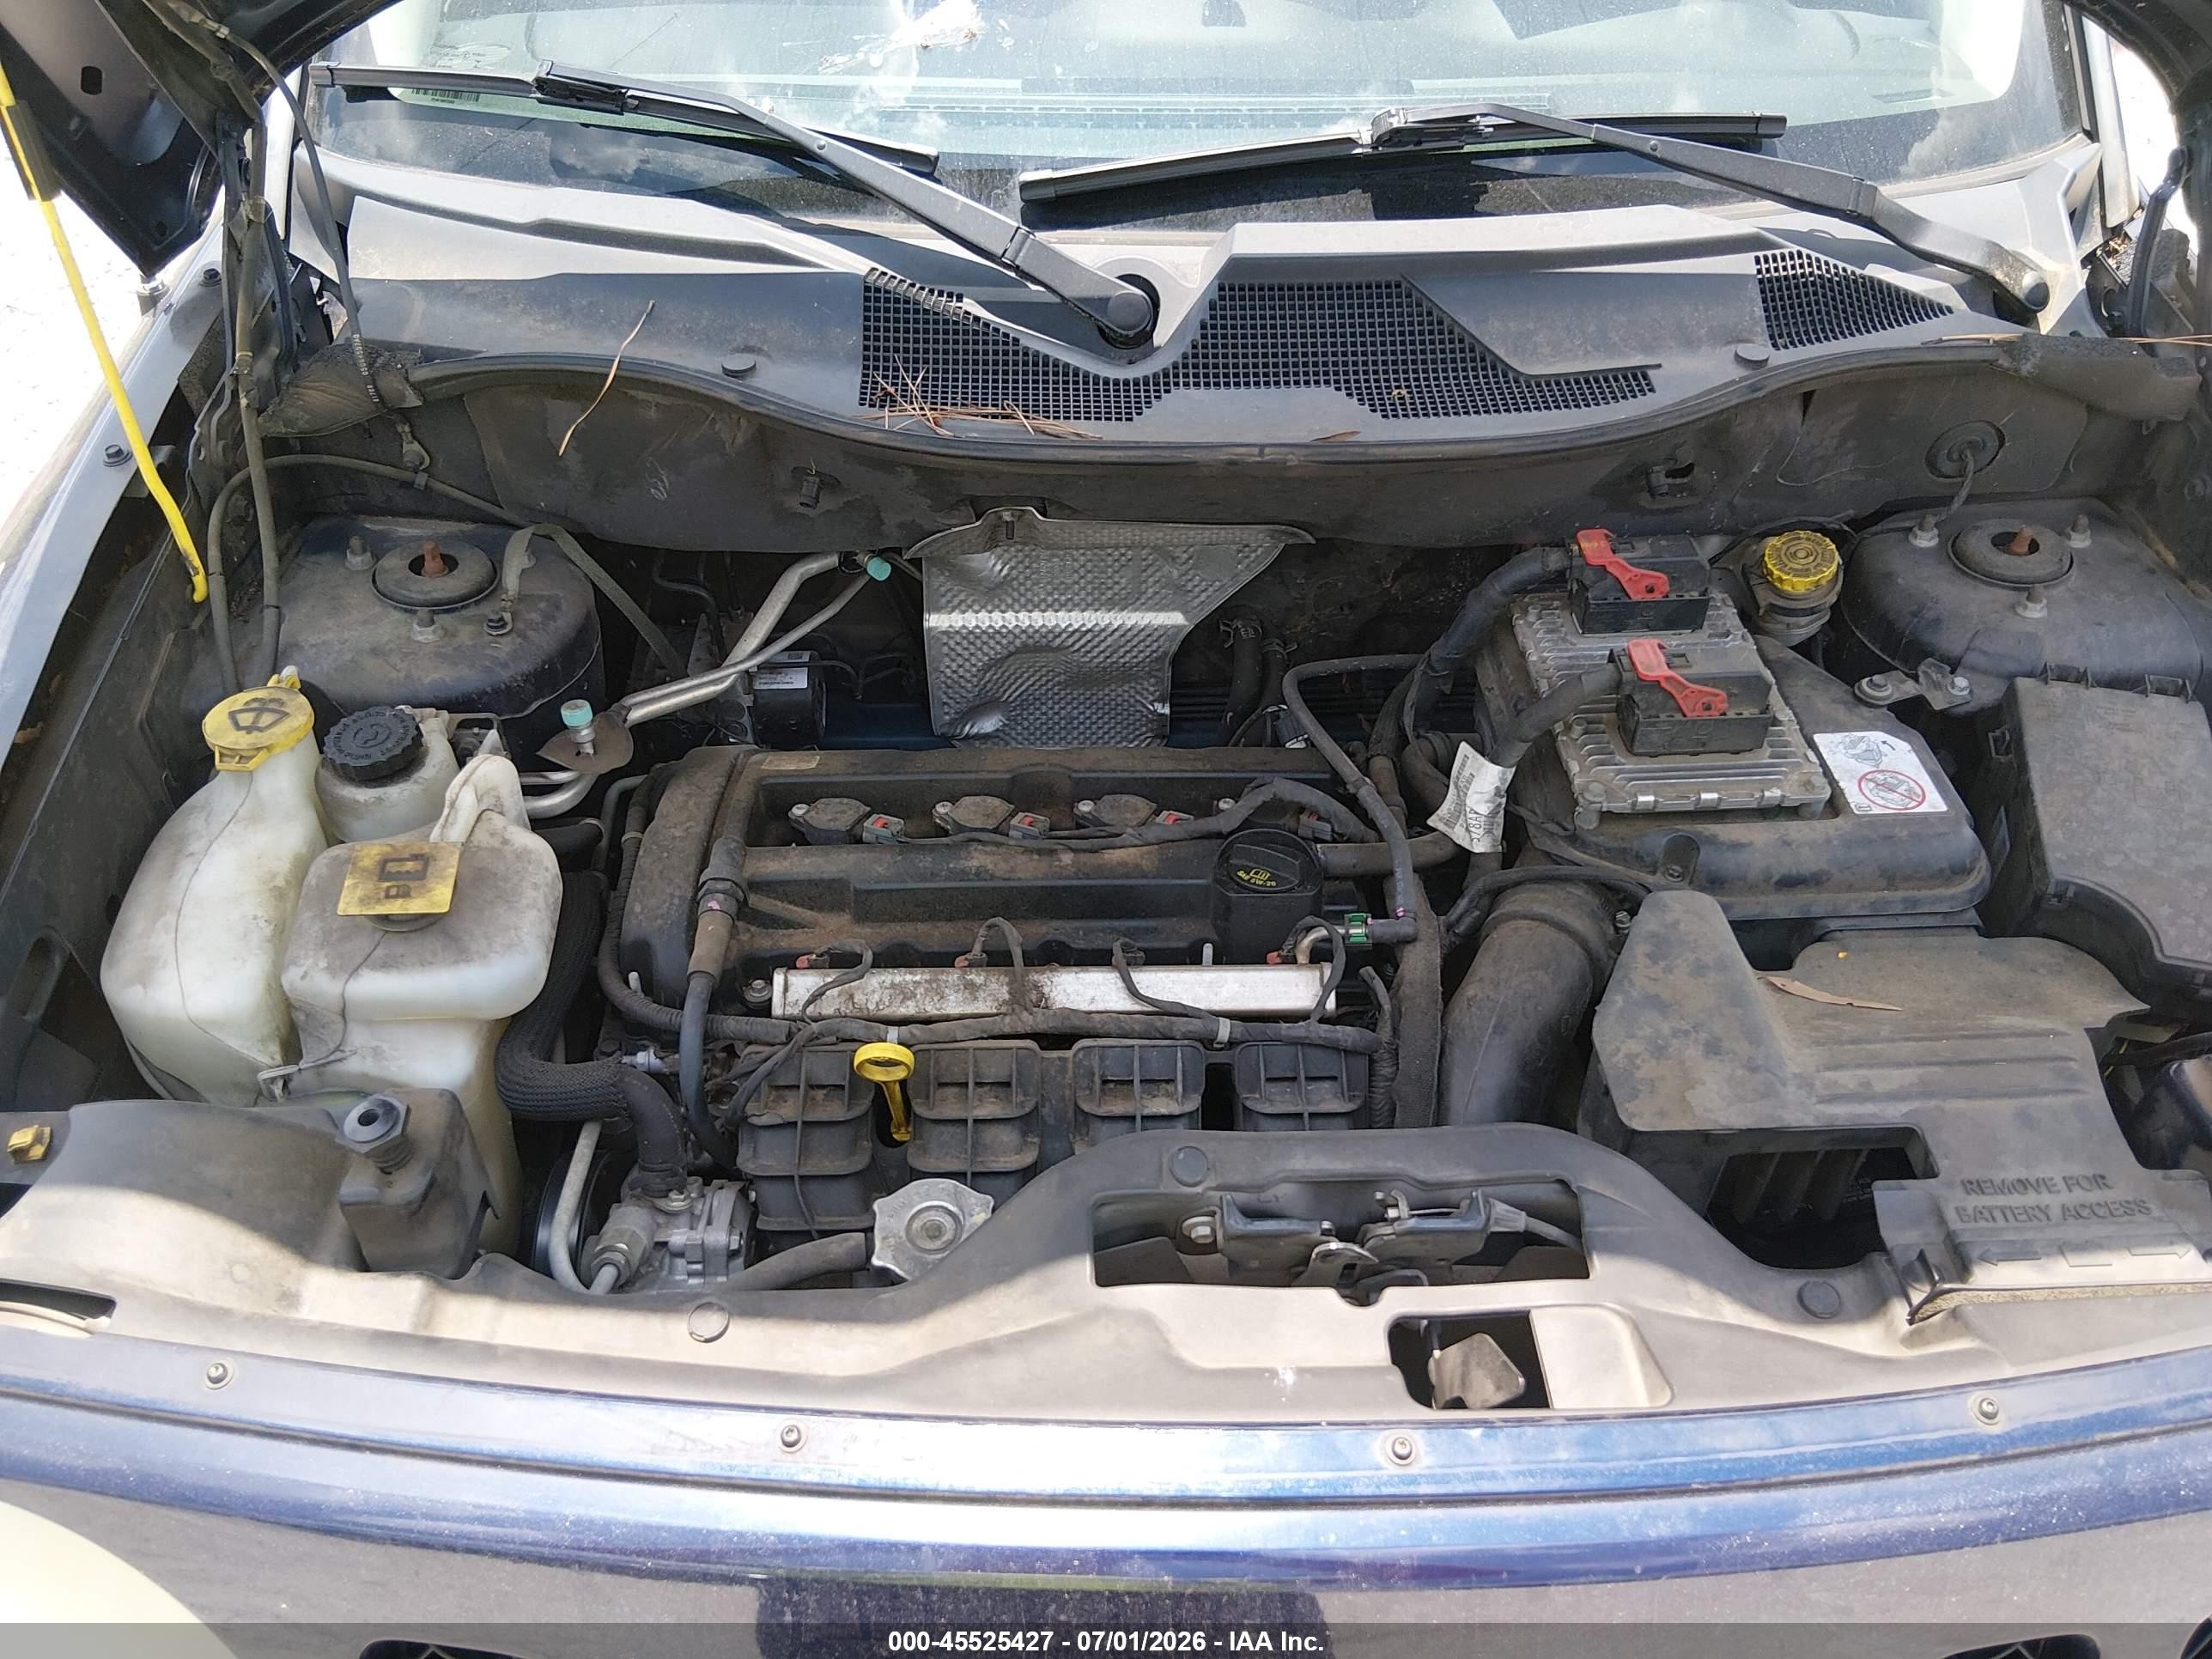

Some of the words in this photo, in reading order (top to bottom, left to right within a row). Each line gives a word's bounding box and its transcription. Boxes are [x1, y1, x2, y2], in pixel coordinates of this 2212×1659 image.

[1960, 1175, 2061, 1196] REMOVE
[2062, 1173, 2113, 1193] FOR
[1954, 1203, 2053, 1224] BATTERY
[2061, 1199, 2153, 1221] ACCESS
